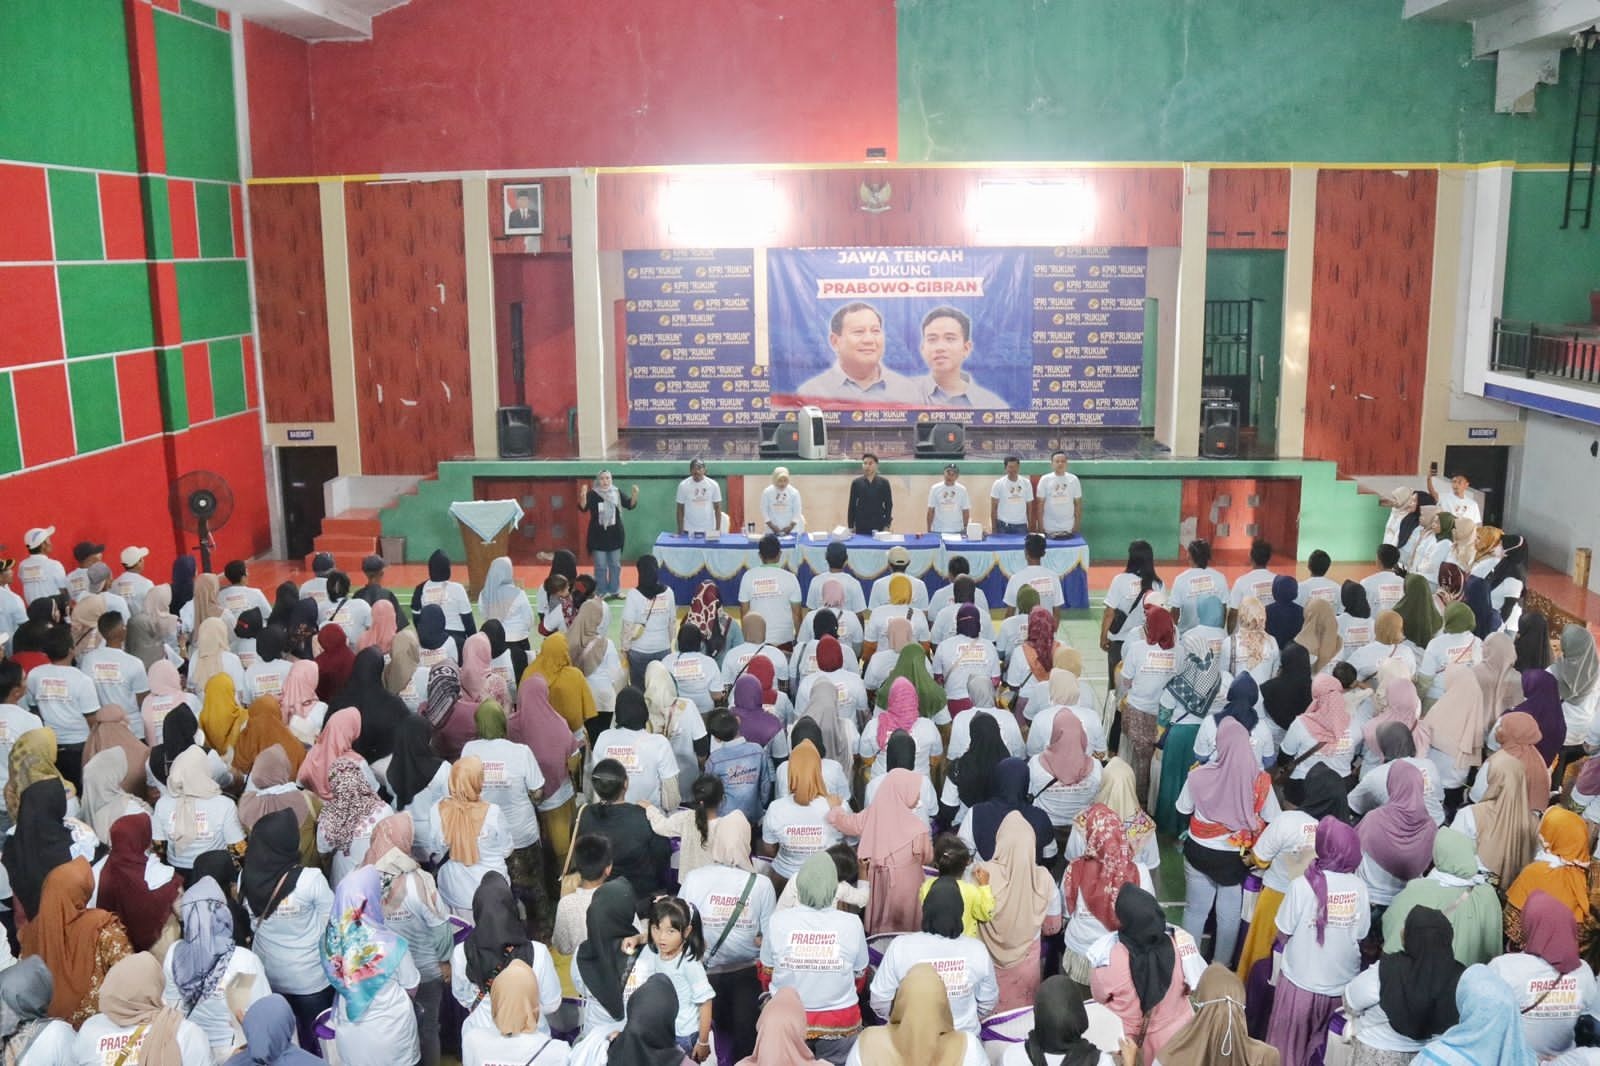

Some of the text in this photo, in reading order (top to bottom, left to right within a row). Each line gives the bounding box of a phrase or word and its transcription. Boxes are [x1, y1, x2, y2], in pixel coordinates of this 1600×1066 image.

[838, 250, 964, 264] JAWA TENGAH
[640, 267, 654, 275] KPRI
[868, 264, 932, 276] DUKUNG
[823, 281, 978, 294] PRABOWO-GIBRAN
[640, 334, 654, 342] KPRI
[702, 399, 716, 407] KPRI
[995, 412, 1010, 420] KPRI
[1328, 893, 1356, 904] ABOWO
[790, 933, 836, 944] PRABOWO
[932, 960, 964, 972] ABOWO
